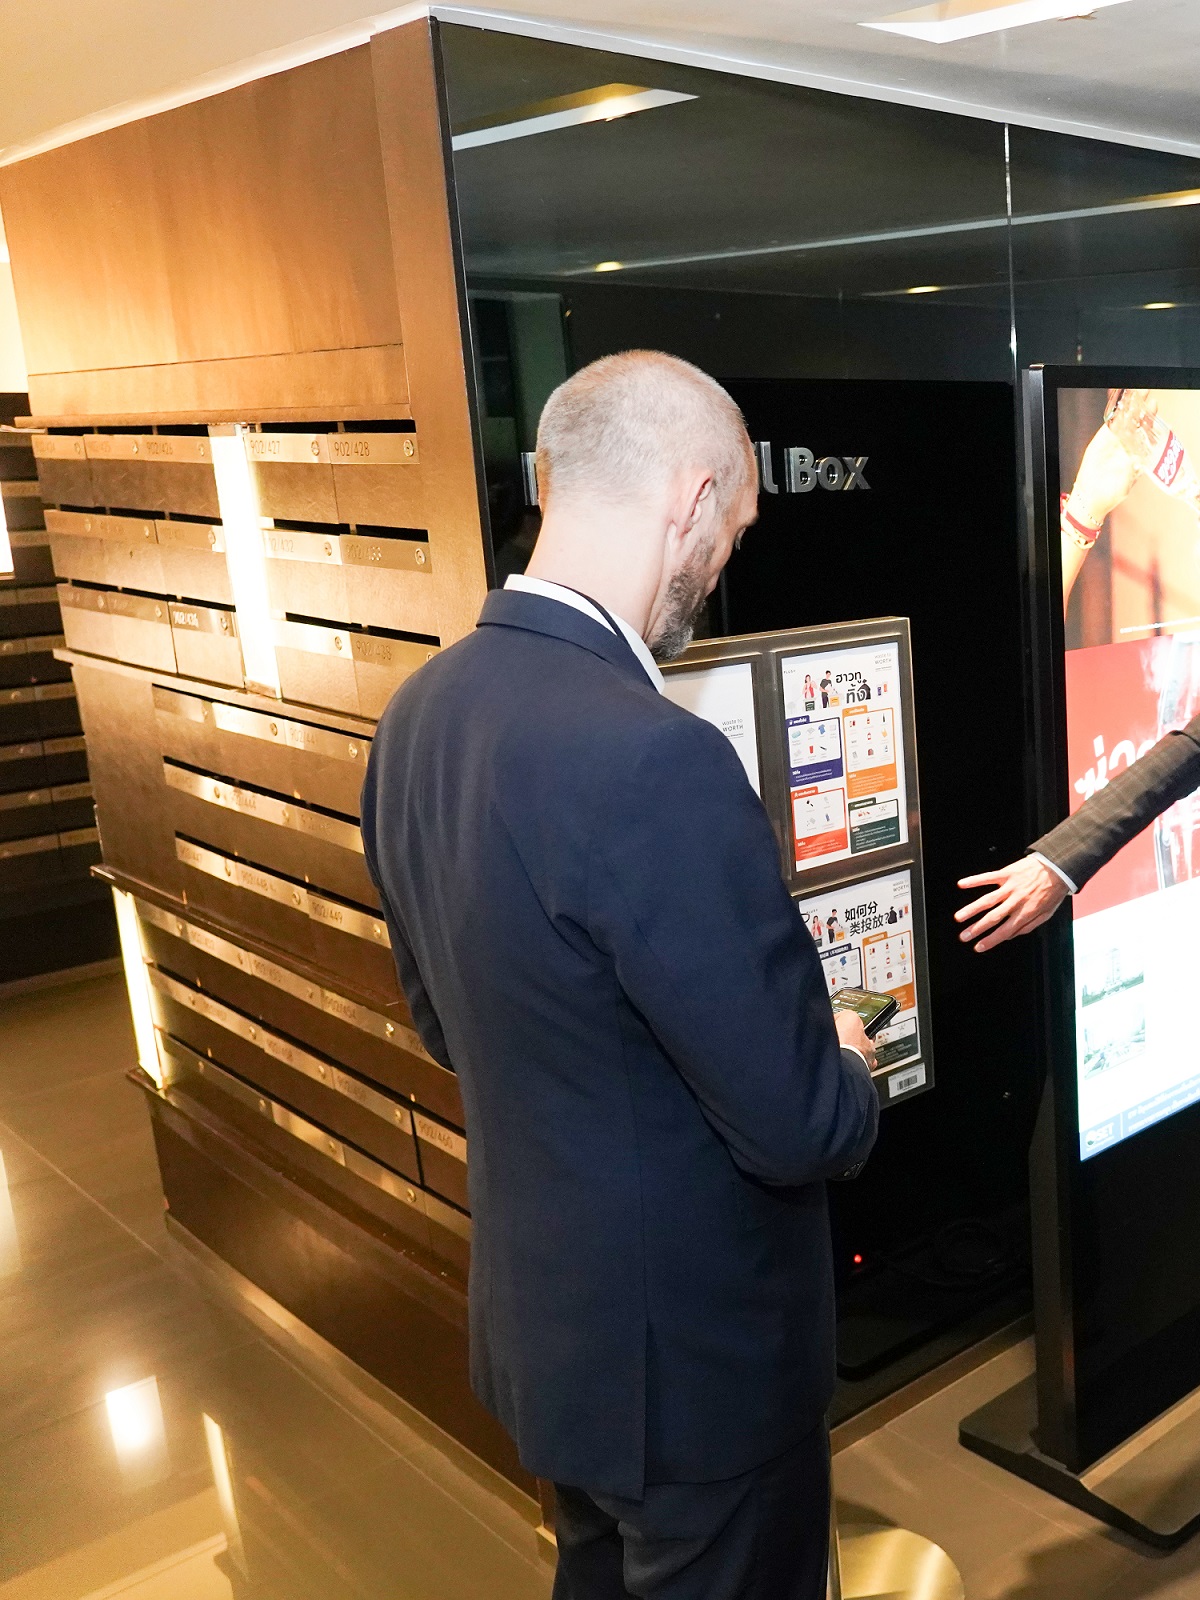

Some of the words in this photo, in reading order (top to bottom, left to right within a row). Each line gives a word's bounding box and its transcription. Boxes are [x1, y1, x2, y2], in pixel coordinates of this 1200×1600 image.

[250, 440, 280, 455] 902/427
[334, 441, 370, 457] 902/428
[784, 445, 872, 494] Box
[356, 640, 393, 660] 902/438
[835, 671, 862, 683] ฮาวทู
[722, 724, 744, 732] WORTH
[845, 901, 878, 923] 如何分
[849, 912, 889, 937] 类投放?
